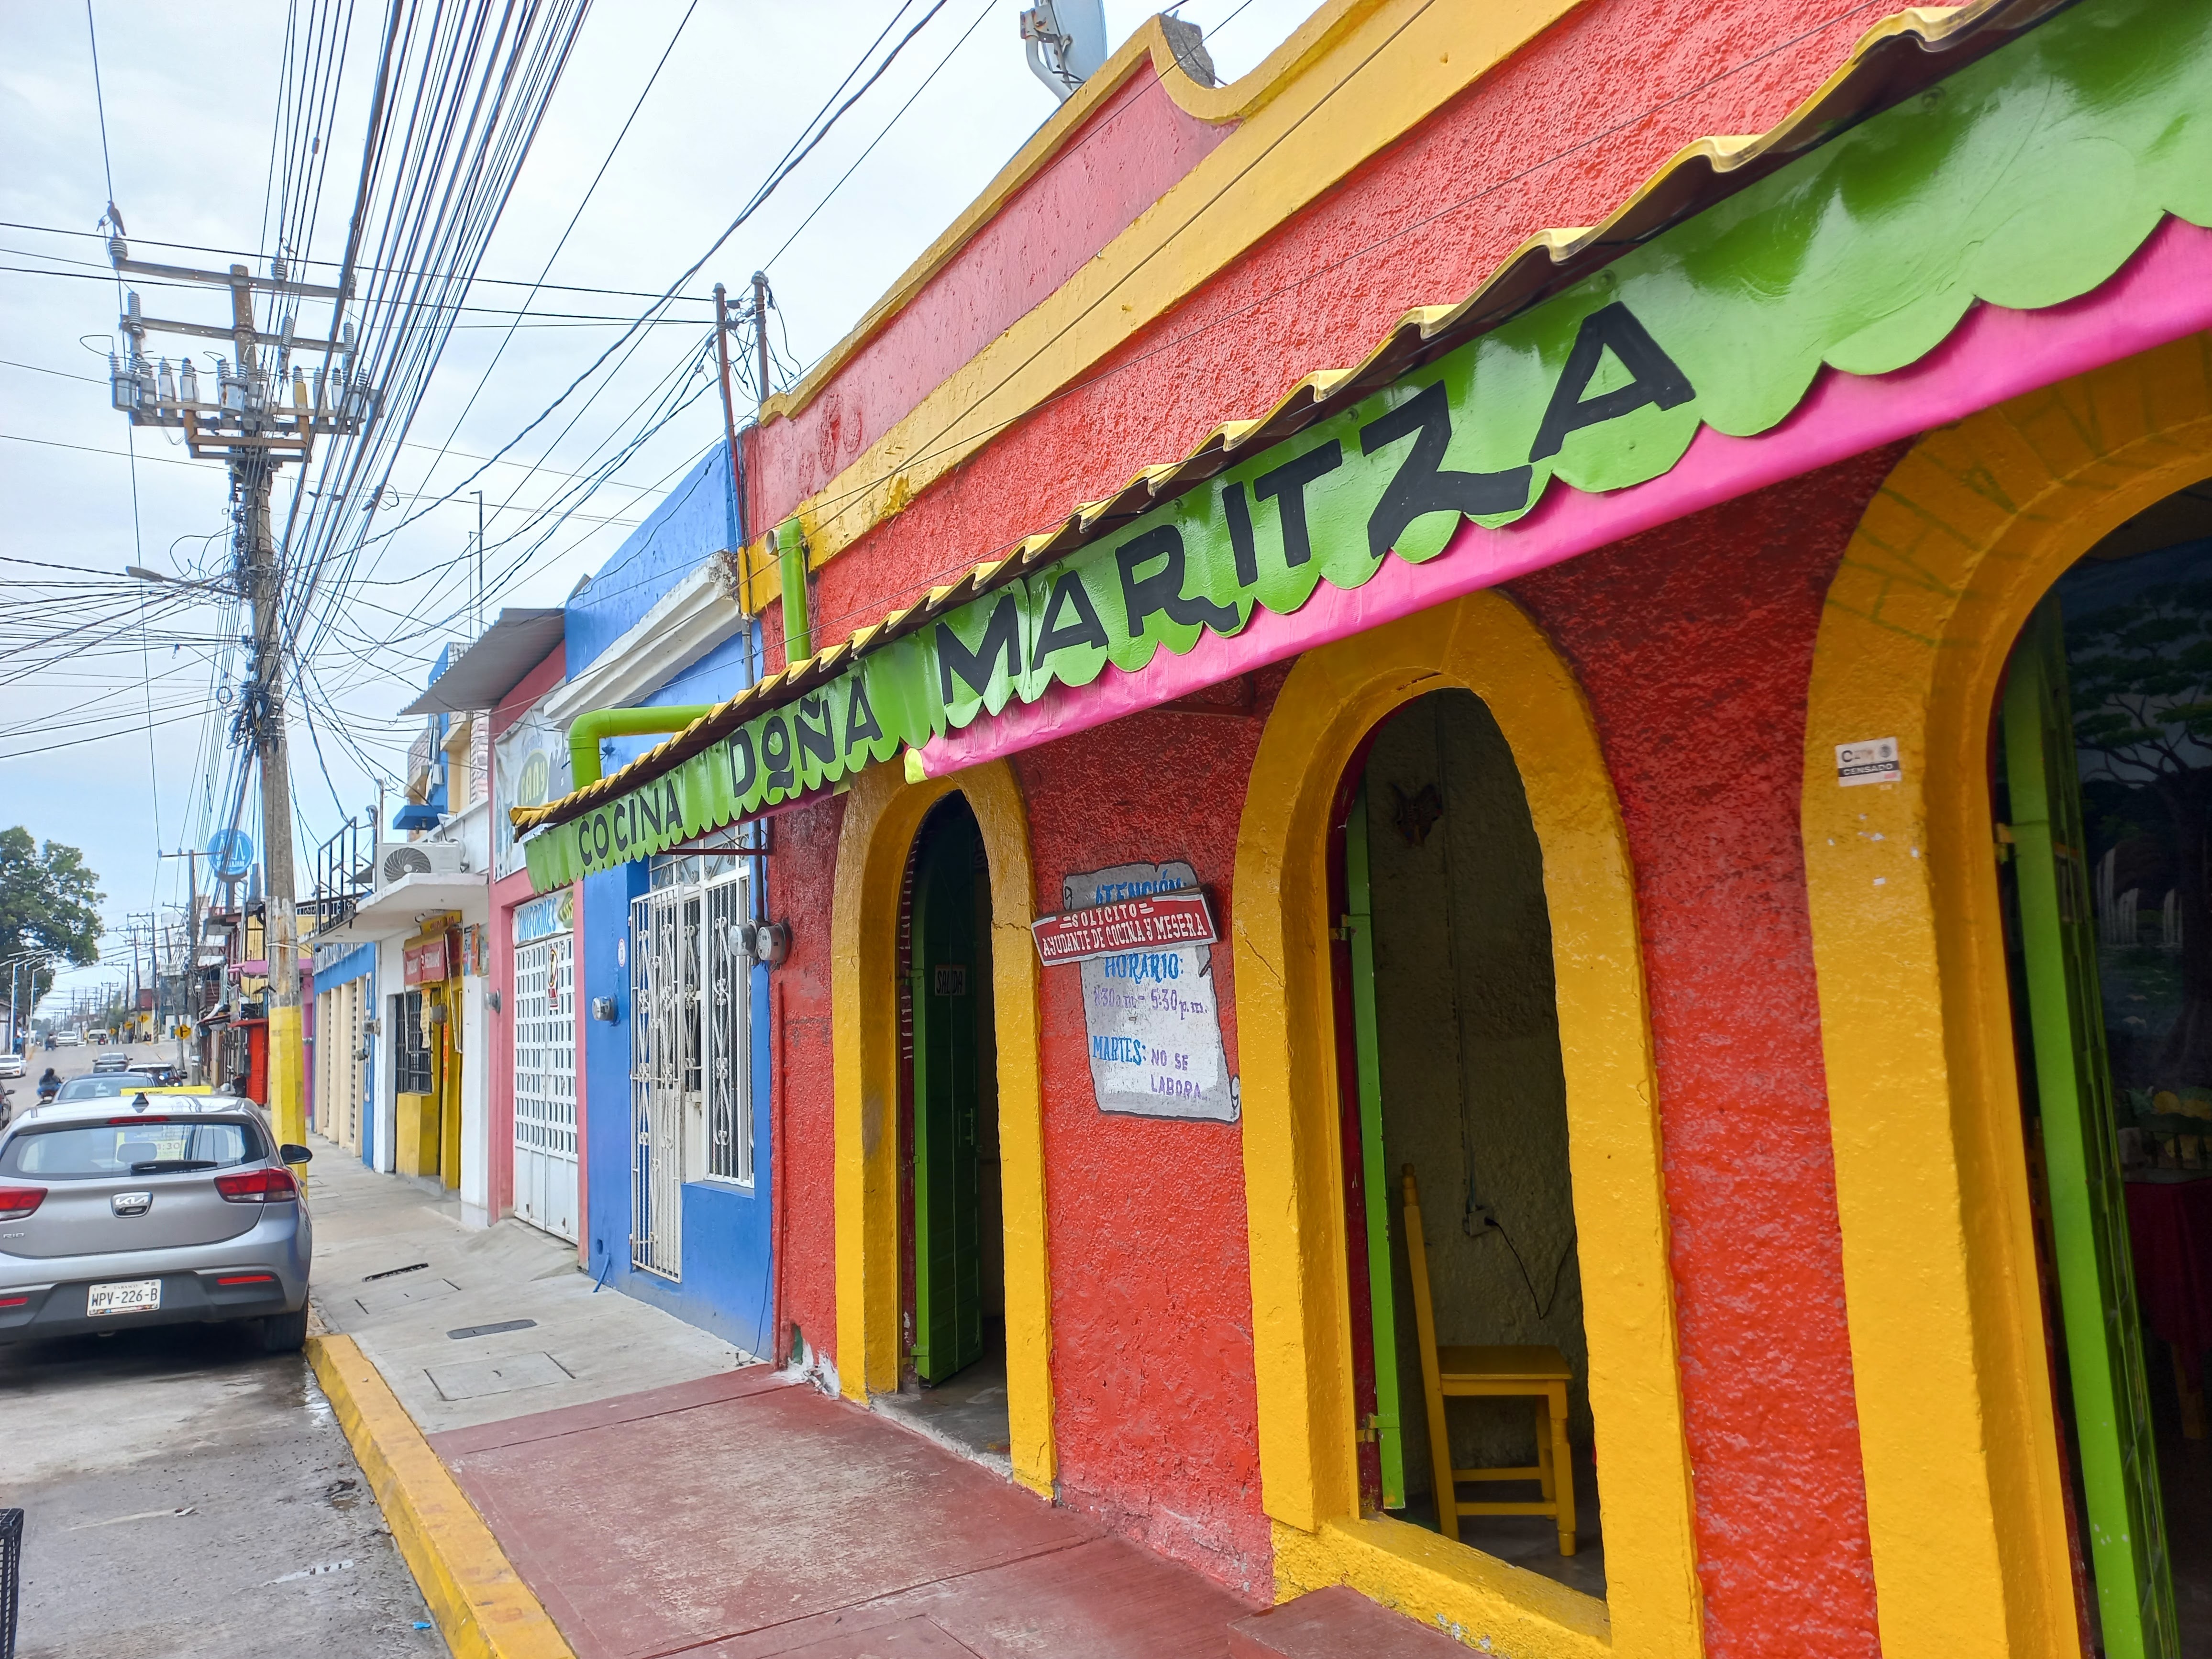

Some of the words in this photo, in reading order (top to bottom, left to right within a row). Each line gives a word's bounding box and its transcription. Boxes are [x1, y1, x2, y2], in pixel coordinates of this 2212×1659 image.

[578, 779, 683, 866] COCINA
[730, 677, 883, 798] DOÑA
[936, 301, 1696, 706] MARITZA
[1843, 763, 1893, 775] CENSADO
[1042, 930, 1091, 957] AYUDANTE
[1091, 927, 1106, 949] DE
[1106, 920, 1146, 946] COCINA
[1143, 918, 1153, 941] Y
[1153, 913, 1207, 940] MESERA
[936, 970, 962, 995] SALDA
[1092, 1035, 1147, 1066] MARTES:
[1151, 1048, 1167, 1067] NO
[1175, 1053, 1189, 1071] SE
[91, 1288, 158, 1306] WPV-226-B
